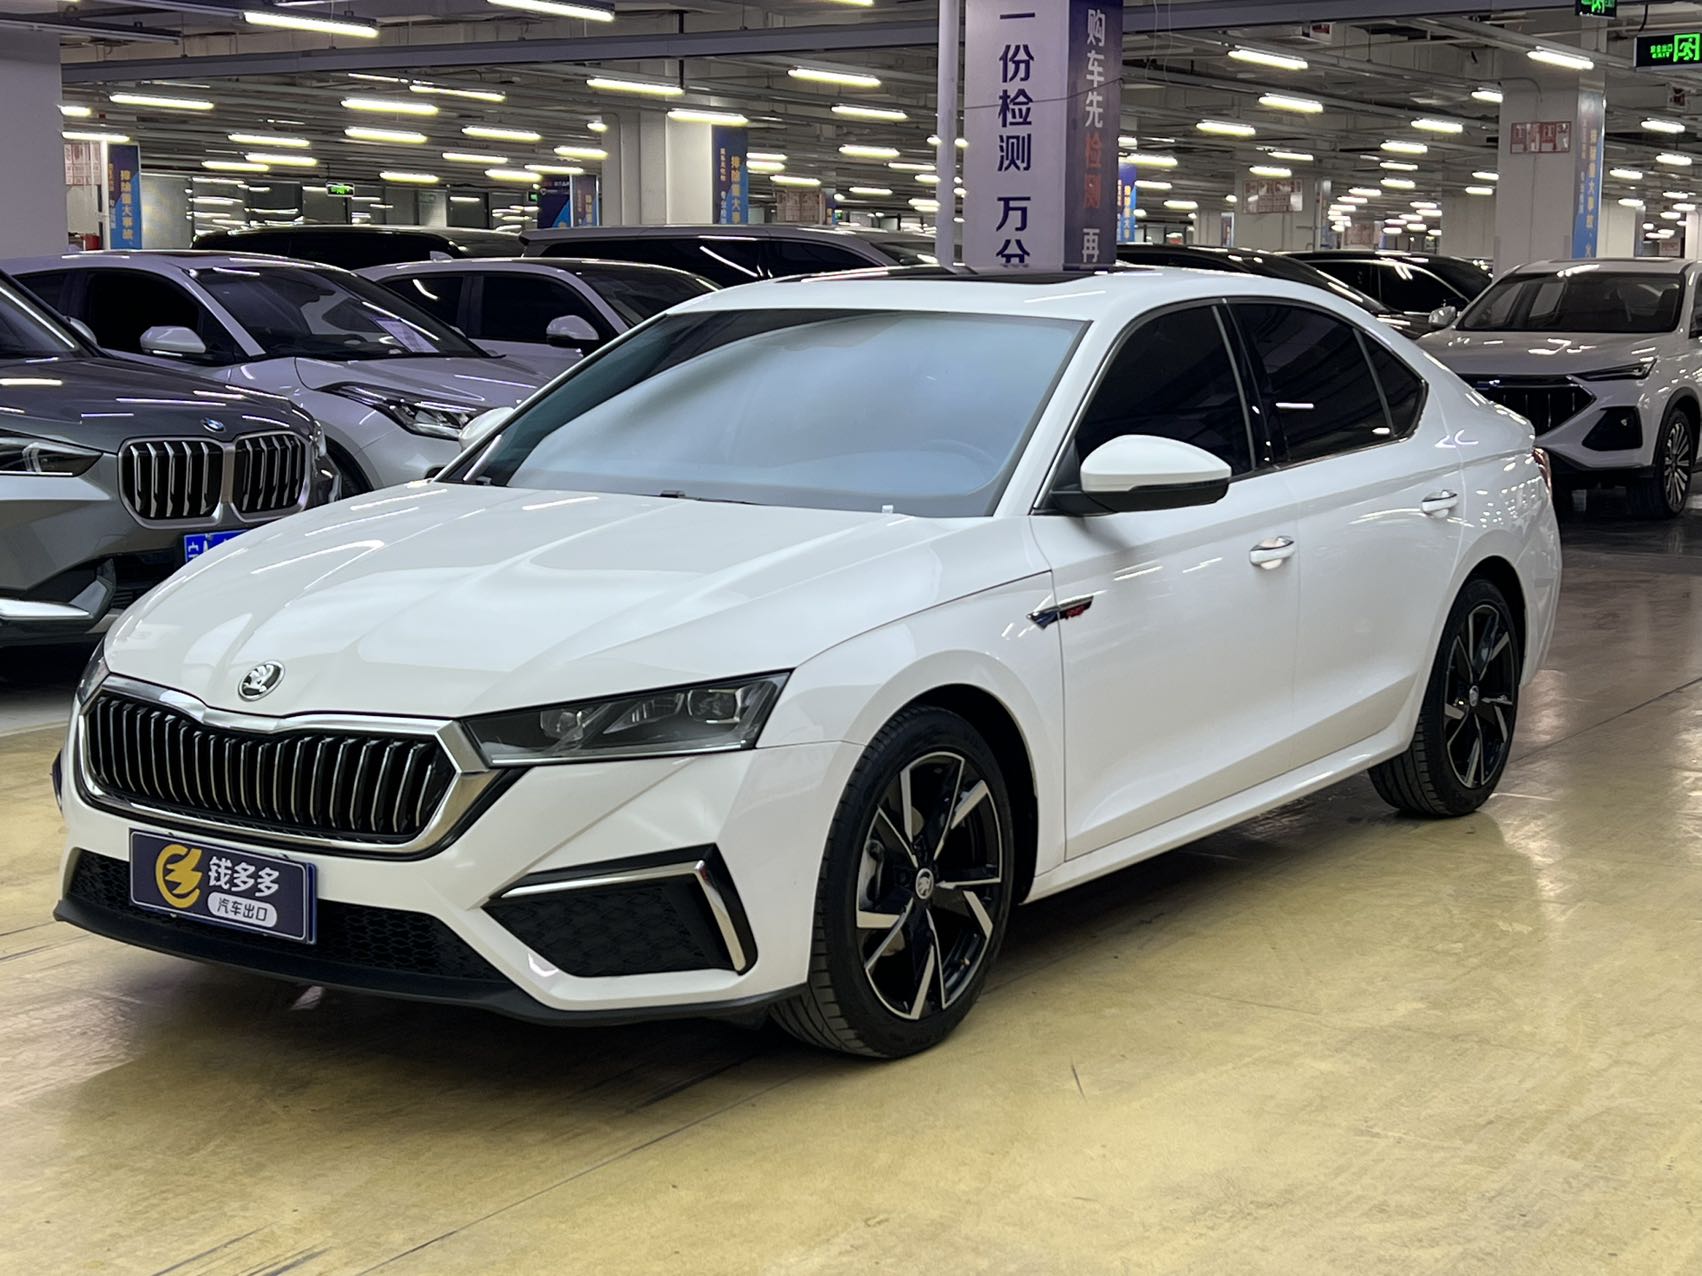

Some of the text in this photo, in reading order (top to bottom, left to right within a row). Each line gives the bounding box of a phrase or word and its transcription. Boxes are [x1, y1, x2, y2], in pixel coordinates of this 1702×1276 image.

[997, 12, 1036, 172] 一份检测
[1081, 9, 1106, 264] 购车先检测 再
[208, 856, 280, 898] 钱多多
[217, 897, 268, 922] 汽车出口
